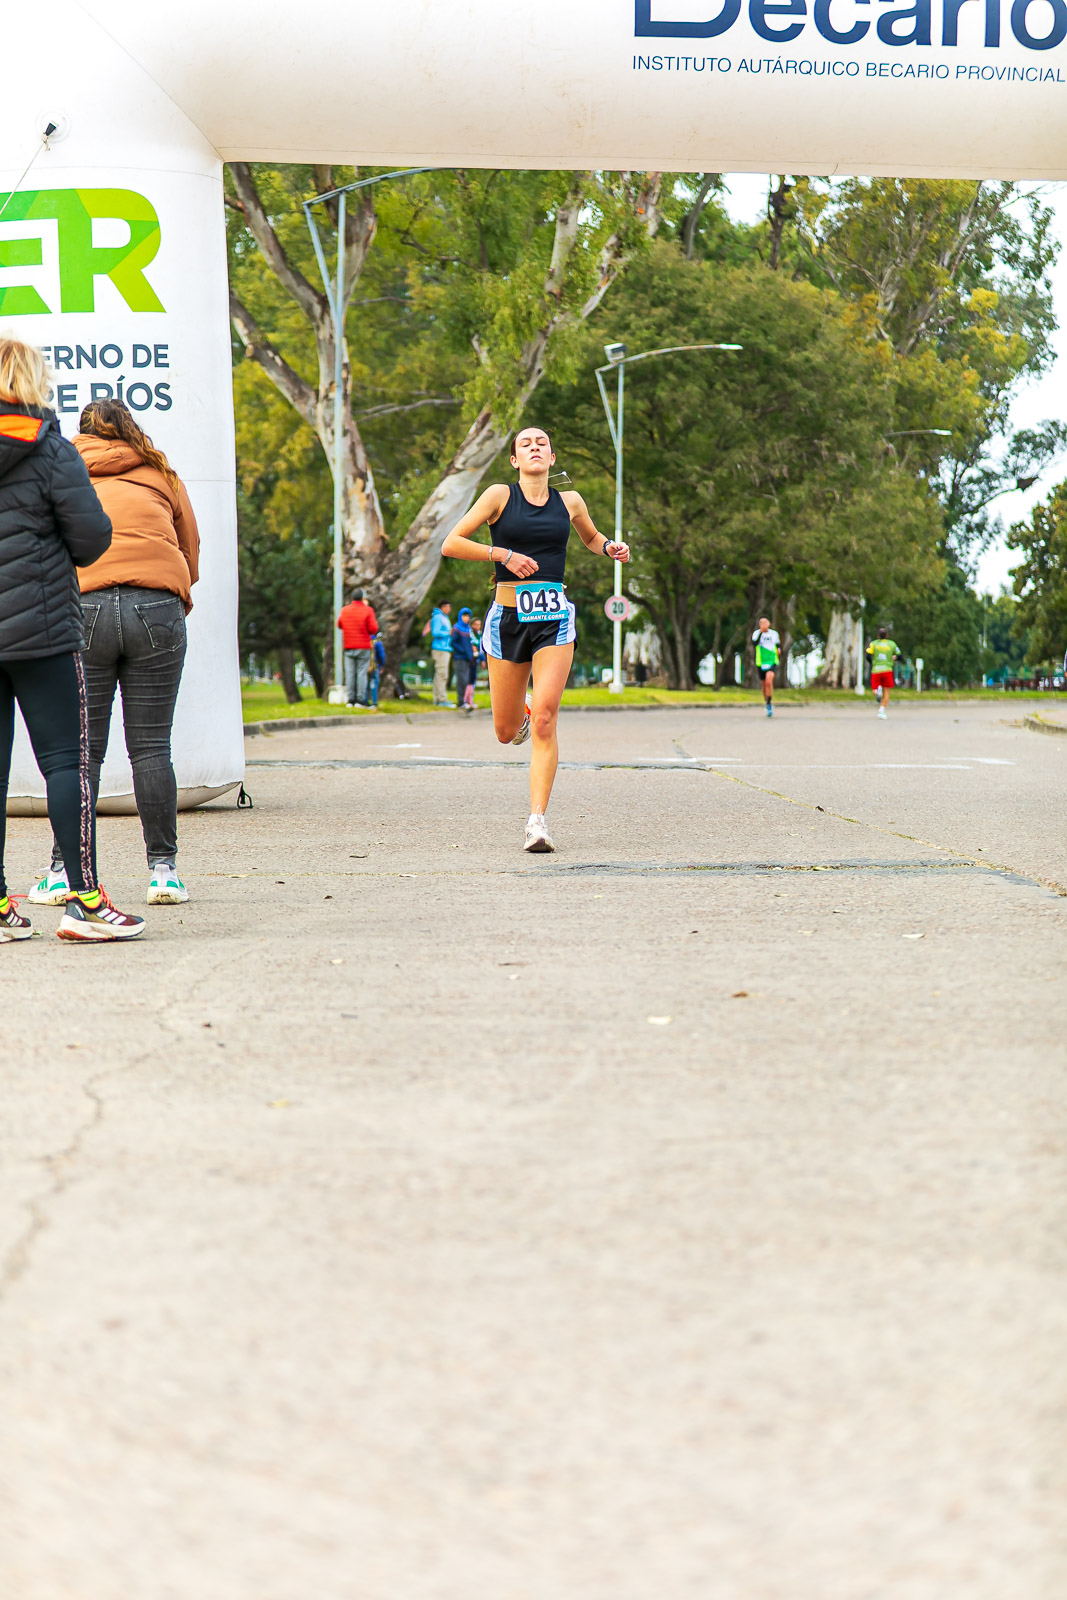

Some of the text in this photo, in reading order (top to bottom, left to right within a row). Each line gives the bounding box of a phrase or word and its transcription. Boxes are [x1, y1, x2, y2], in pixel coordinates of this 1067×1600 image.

[632, 55, 1066, 83] INSTITUTO AUTÁRQUICO BECARIO PROVINCIAL
[132, 344, 170, 369] DE
[90, 374, 173, 412] RÍOS
[520, 588, 561, 614] 043
[612, 602, 624, 613] 20
